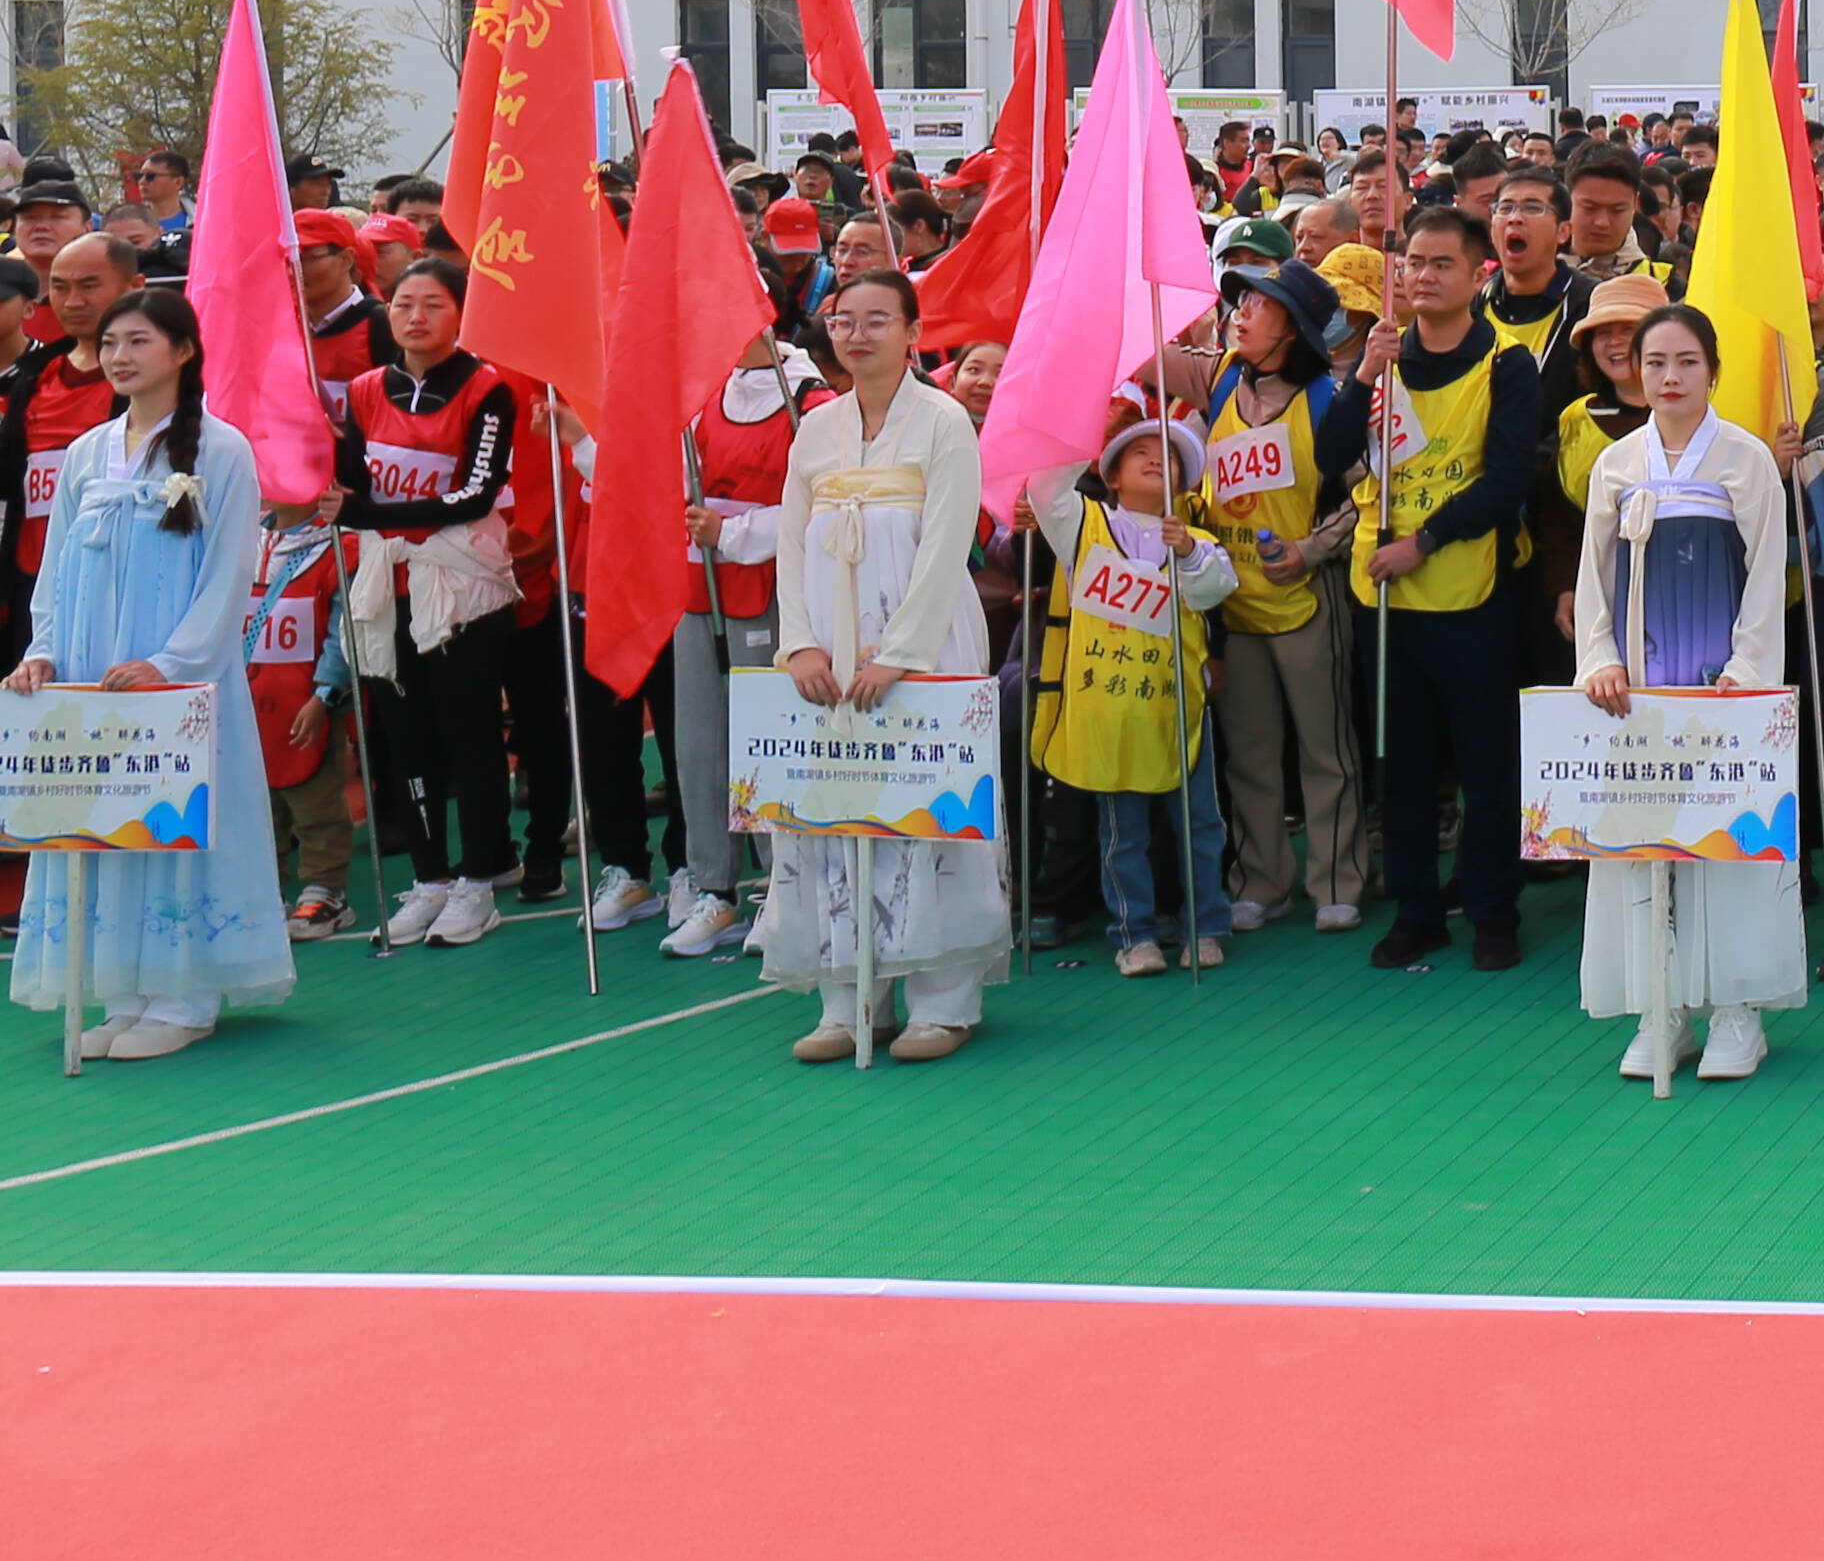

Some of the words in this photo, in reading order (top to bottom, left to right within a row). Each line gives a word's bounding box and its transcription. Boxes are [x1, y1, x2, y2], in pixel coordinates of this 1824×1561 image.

[1216, 442, 1282, 492] A249
[1084, 565, 1171, 621] A277
[1084, 638, 1176, 665] 山水田
[0, 752, 191, 774] 4年徒步齐鲁“东港”站
[747, 738, 975, 764] 2024年徒步齐鲁“东港”站
[1540, 761, 1777, 782] 2024年徒步齐鲁“东港”站
